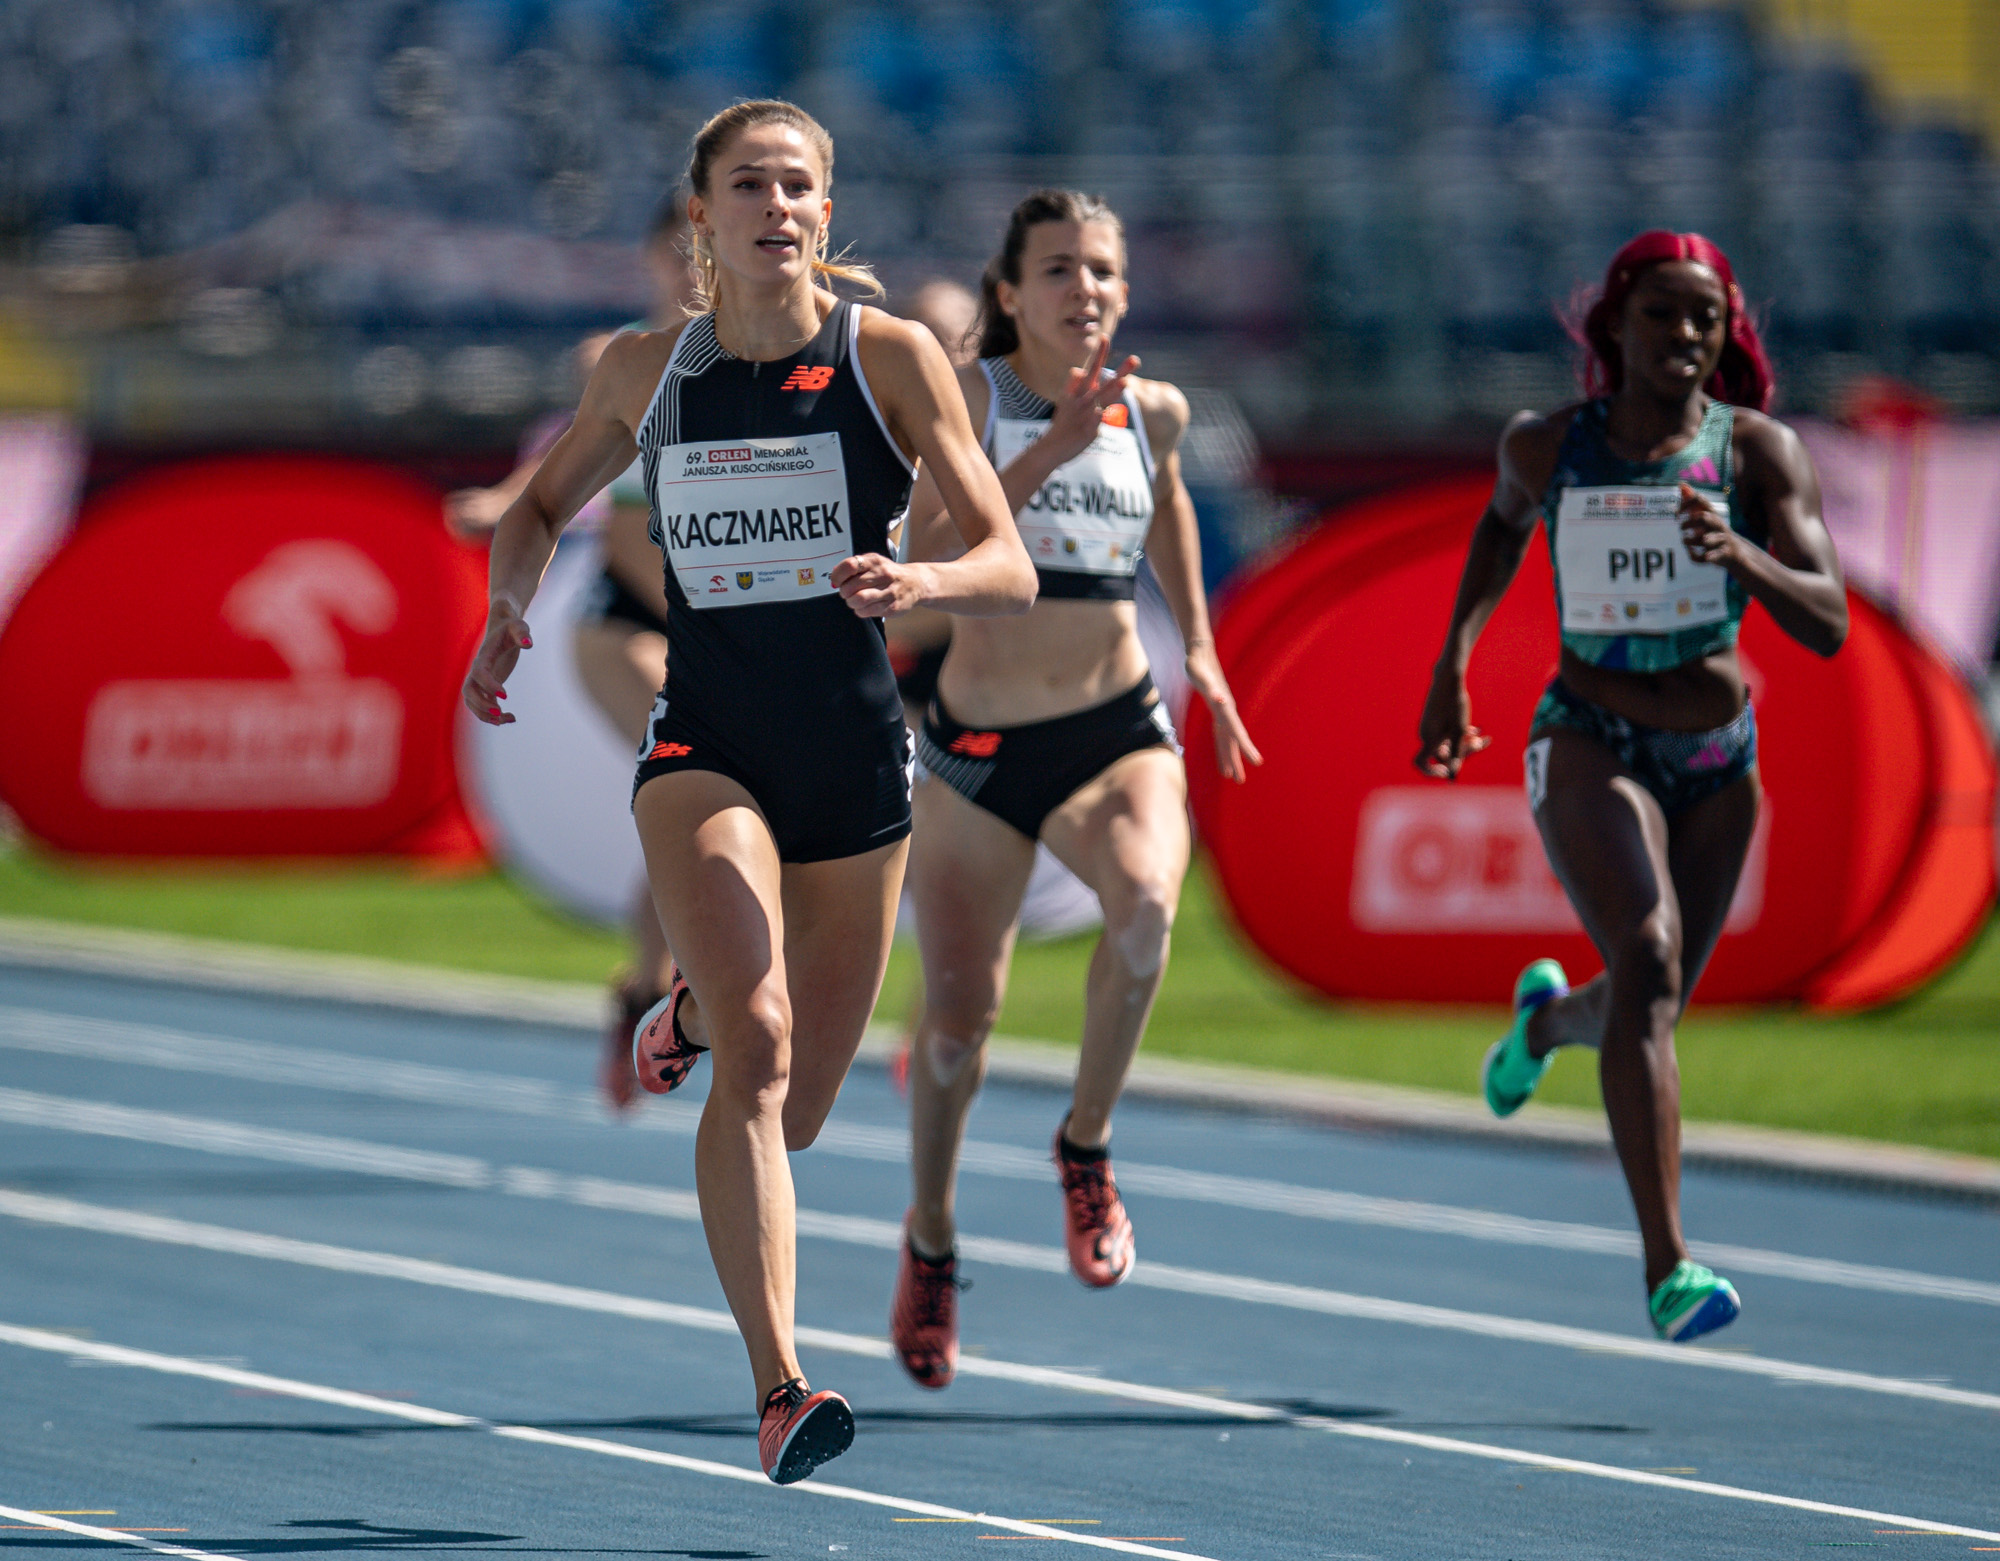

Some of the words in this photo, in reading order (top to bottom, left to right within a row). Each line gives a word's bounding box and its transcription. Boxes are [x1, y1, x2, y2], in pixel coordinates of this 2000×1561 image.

[779, 365, 836, 392] NB
[682, 464, 728, 477] JANUSZA
[730, 459, 815, 474] KUSOCIŃSKIEGO
[686, 451, 706, 465] 69.
[709, 449, 751, 463] ORLEN
[754, 446, 809, 459] MEMORIAŁ
[1028, 481, 1145, 519] OGL-WALLI
[667, 501, 844, 550] KACZMAREK
[1608, 548, 1677, 582] PIPI
